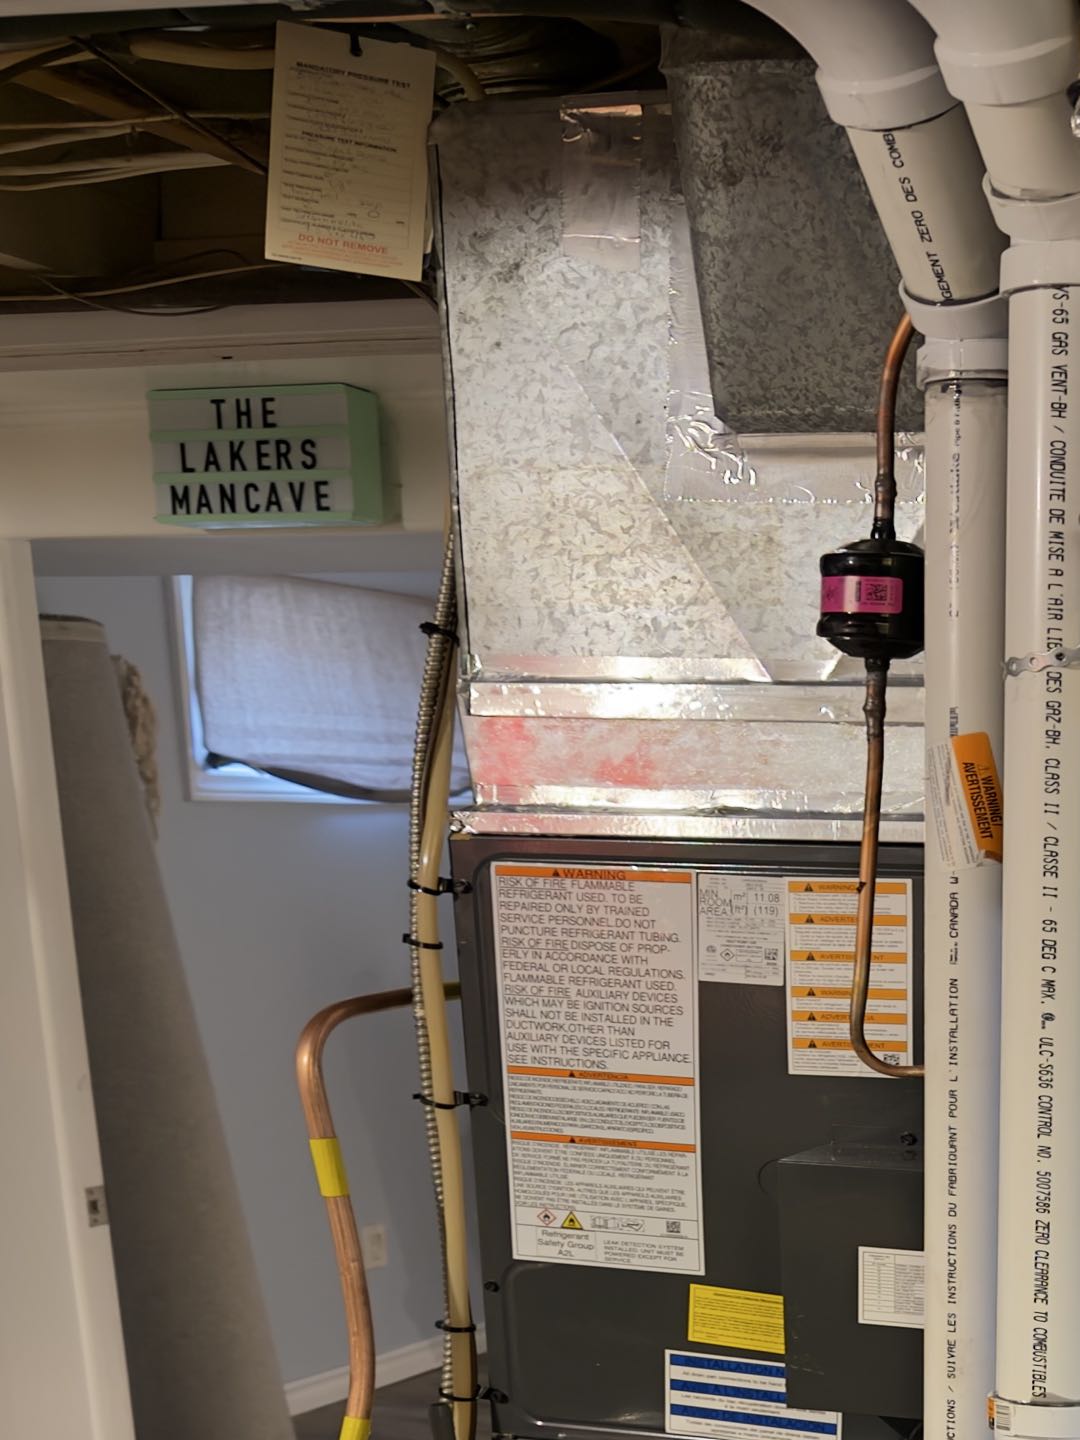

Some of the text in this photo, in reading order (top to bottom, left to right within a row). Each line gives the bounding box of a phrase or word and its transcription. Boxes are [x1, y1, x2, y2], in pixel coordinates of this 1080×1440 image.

[899, 176, 918, 203] DES
[911, 210, 932, 243] ZERO
[298, 234, 388, 254] DO NOT REMOVE
[1052, 332, 1069, 355] GAS
[1050, 364, 1068, 419] VENT-BH
[210, 397, 277, 429] THE
[180, 439, 317, 473] LAKERS
[1049, 440, 1067, 502] CONDUITE
[170, 481, 330, 515] MANCAVE
[1049, 508, 1065, 525] DE
[1048, 531, 1064, 562] MISE
[1049, 568, 1064, 577] A
[1047, 583, 1063, 620] L'AIR
[1044, 758, 1061, 794] CLASS
[962, 762, 993, 839] AVERTISSEMENT
[1044, 803, 1060, 815] II
[1043, 836, 1059, 879] CLASSE
[498, 876, 634, 891] RISK OF FIRE FLAMMABLE
[563, 869, 625, 880] WARNING
[498, 888, 573, 901] REFRIGERANT
[611, 893, 626, 903] TO
[629, 894, 642, 904] BE
[1042, 886, 1058, 898] II
[499, 900, 649, 916] REPAIRED ONLY BY TRAINED
[949, 892, 959, 938] CANADA
[499, 912, 544, 923] SERVICE
[634, 918, 656, 929] NOT
[500, 924, 557, 936] PUNCTURE
[560, 927, 635, 940] REFRIGERANT
[1042, 919, 1057, 933] 65
[501, 936, 525, 946] RISK
[527, 938, 542, 947] OF
[545, 939, 568, 949] FIRE
[570, 940, 616, 951] DISPOSE
[619, 942, 633, 952] OF
[1041, 939, 1057, 960] DEG
[501, 948, 648, 965] ERLY IN ACCORDANCE WITH
[502, 960, 549, 971] FEDERAL
[552, 963, 568, 972] OR
[570, 964, 604, 974] LOCAL
[503, 972, 564, 984] FLAMMABLE
[568, 976, 641, 988] REFRIGERANT
[1041, 979, 1056, 1004] MAX.
[504, 984, 677, 1002] RISK OF FIRE AUXILIARY DEVICES
[1038, 1037, 1054, 1089] ULC-S636
[948, 1090, 958, 1118] POUR
[1037, 1095, 1053, 1139] CONTROL
[948, 1126, 957, 1196] FABRIQUANT
[1037, 1145, 1052, 1162] NO.
[1036, 1171, 1051, 1214] 5007586
[948, 1202, 957, 1217] DU
[541, 1230, 588, 1241] Refrigerant
[1035, 1219, 1050, 1245] ZERO
[537, 1238, 593, 1250] Safety Group
[947, 1224, 957, 1304] INSTRUCTIONS
[1033, 1250, 1049, 1305] CLEARANCE
[947, 1313, 956, 1333] LES
[1033, 1311, 1048, 1323] TO
[947, 1340, 956, 1378] SUIVRE
[1031, 1327, 1049, 1400] COMBUSTIBLES
